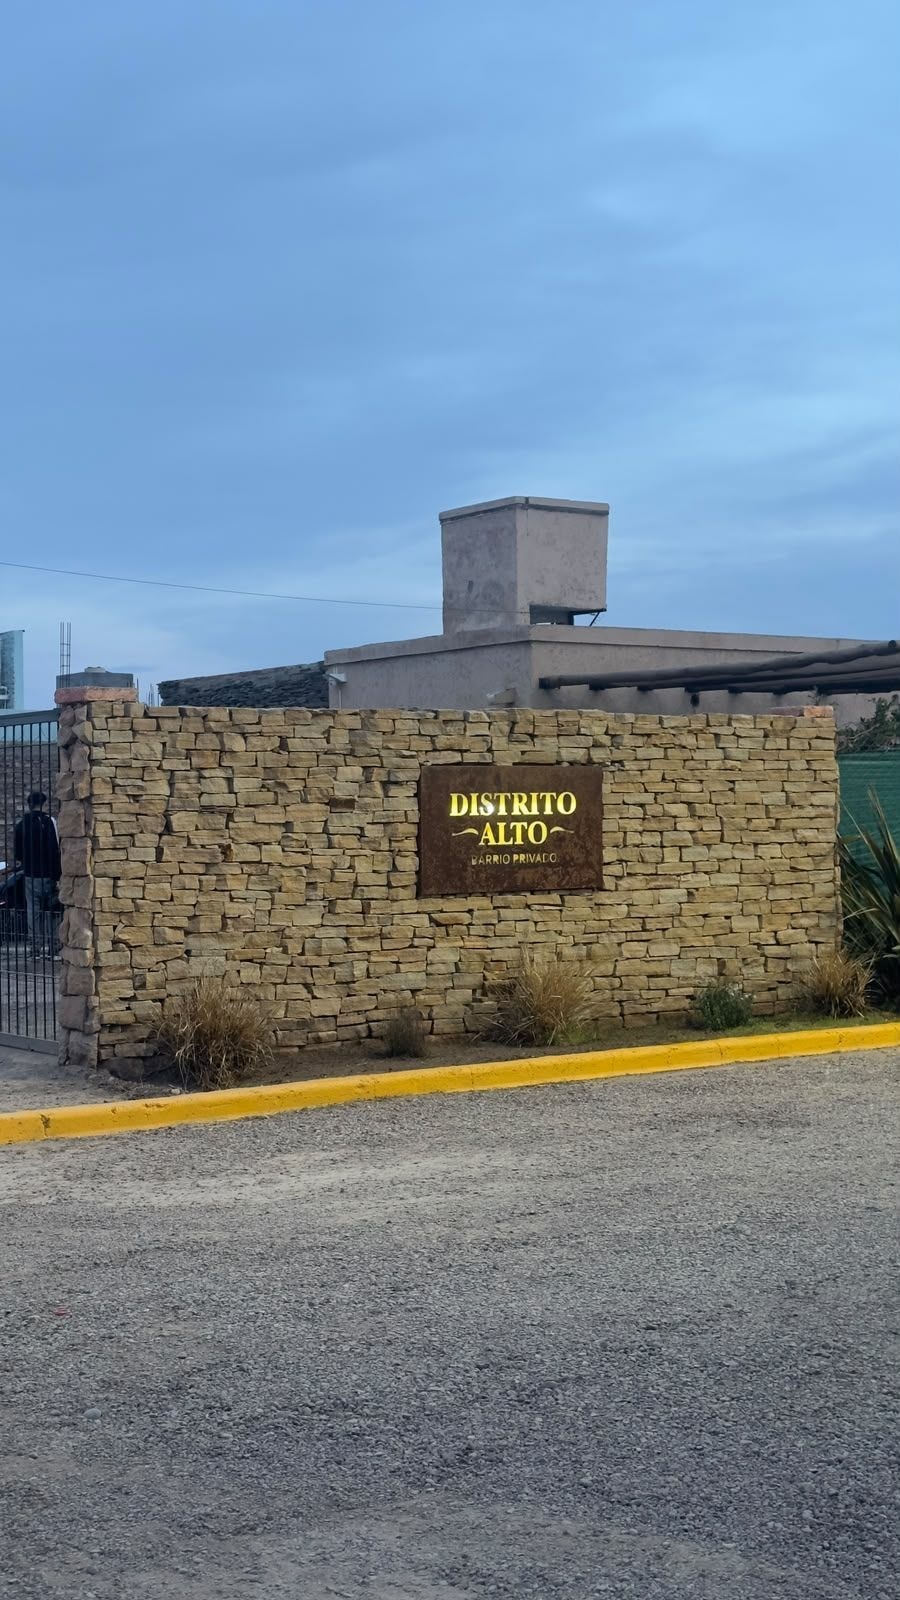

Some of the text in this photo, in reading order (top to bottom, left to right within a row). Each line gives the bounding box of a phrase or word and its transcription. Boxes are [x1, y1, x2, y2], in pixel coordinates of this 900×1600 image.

[449, 791, 577, 817] DISTRITO
[478, 821, 548, 846] ALTO
[471, 853, 557, 866] BARRIO PRIVADO
